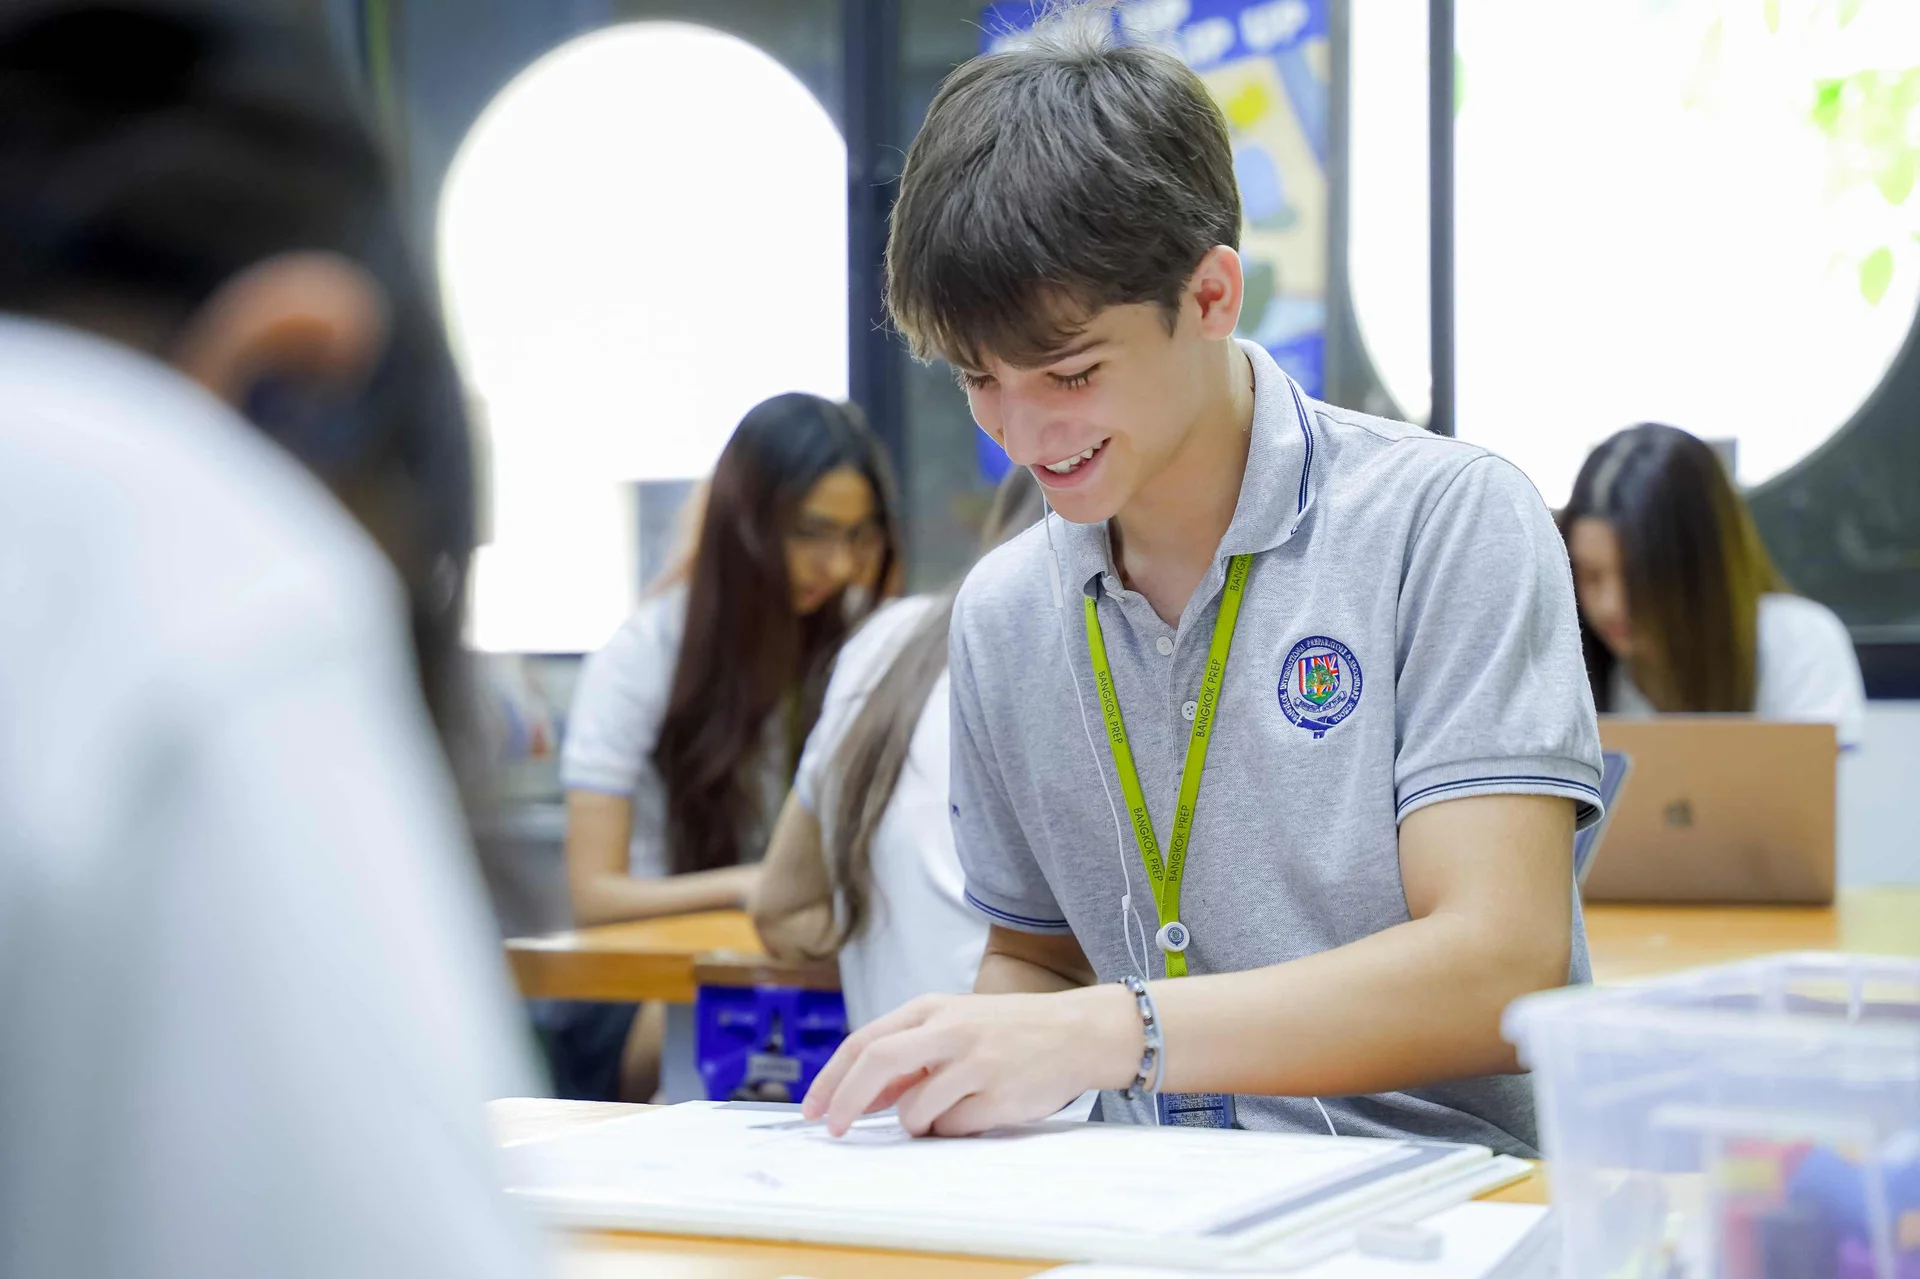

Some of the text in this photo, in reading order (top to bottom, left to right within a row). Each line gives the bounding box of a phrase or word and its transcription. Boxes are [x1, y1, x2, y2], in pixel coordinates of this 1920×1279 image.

[1230, 554, 1248, 591] BANGK
[1098, 670, 1123, 744] BANGKOK PREP
[1196, 658, 1221, 737] BANGKOK PREP
[1133, 807, 1163, 882] BANGKOK PREP
[1169, 804, 1189, 882] BANGKOK PREP
